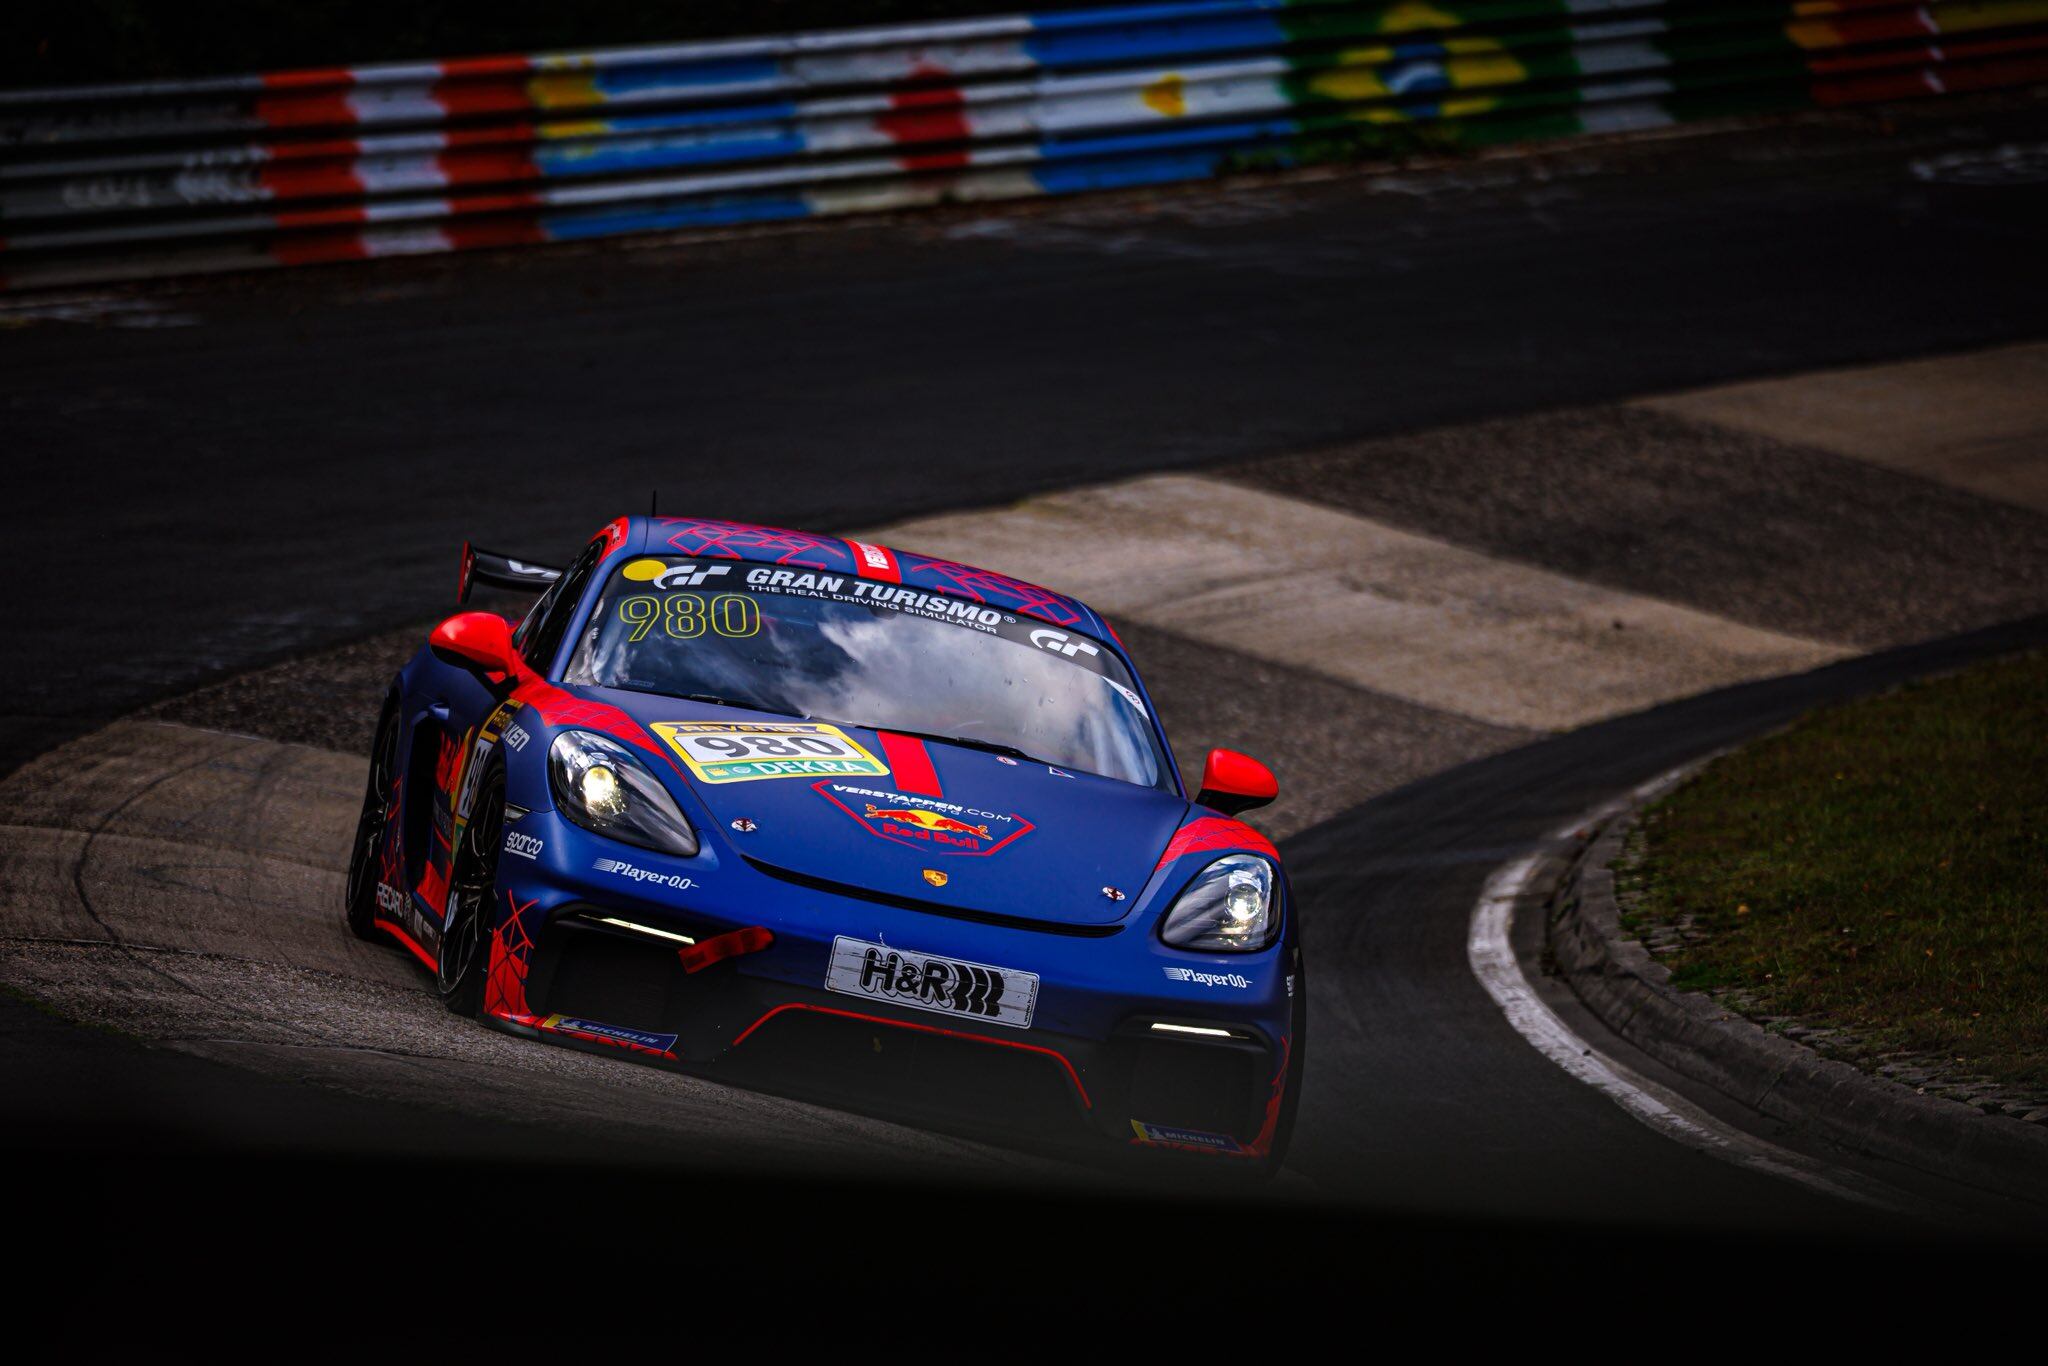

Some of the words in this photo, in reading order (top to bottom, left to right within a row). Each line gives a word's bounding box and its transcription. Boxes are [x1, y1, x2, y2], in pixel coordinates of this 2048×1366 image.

[746, 569, 843, 593] GRAN
[619, 594, 761, 642] 980
[748, 585, 781, 594] THE
[786, 588, 829, 600] REAL
[833, 594, 899, 611] DRIVING
[904, 606, 998, 634] SIMULATOR
[695, 737, 845, 758] 980
[751, 760, 869, 775] DEKRA
[833, 785, 1012, 823] VERSTAPPEN.COM
[889, 799, 960, 815] RACING
[506, 831, 543, 856] sparco
[882, 823, 930, 841] Red
[934, 832, 980, 850] Bull
[861, 948, 957, 1009] H&R
[582, 1024, 659, 1044] MICHELIN
[1165, 1131, 1225, 1145] MICHELIN
